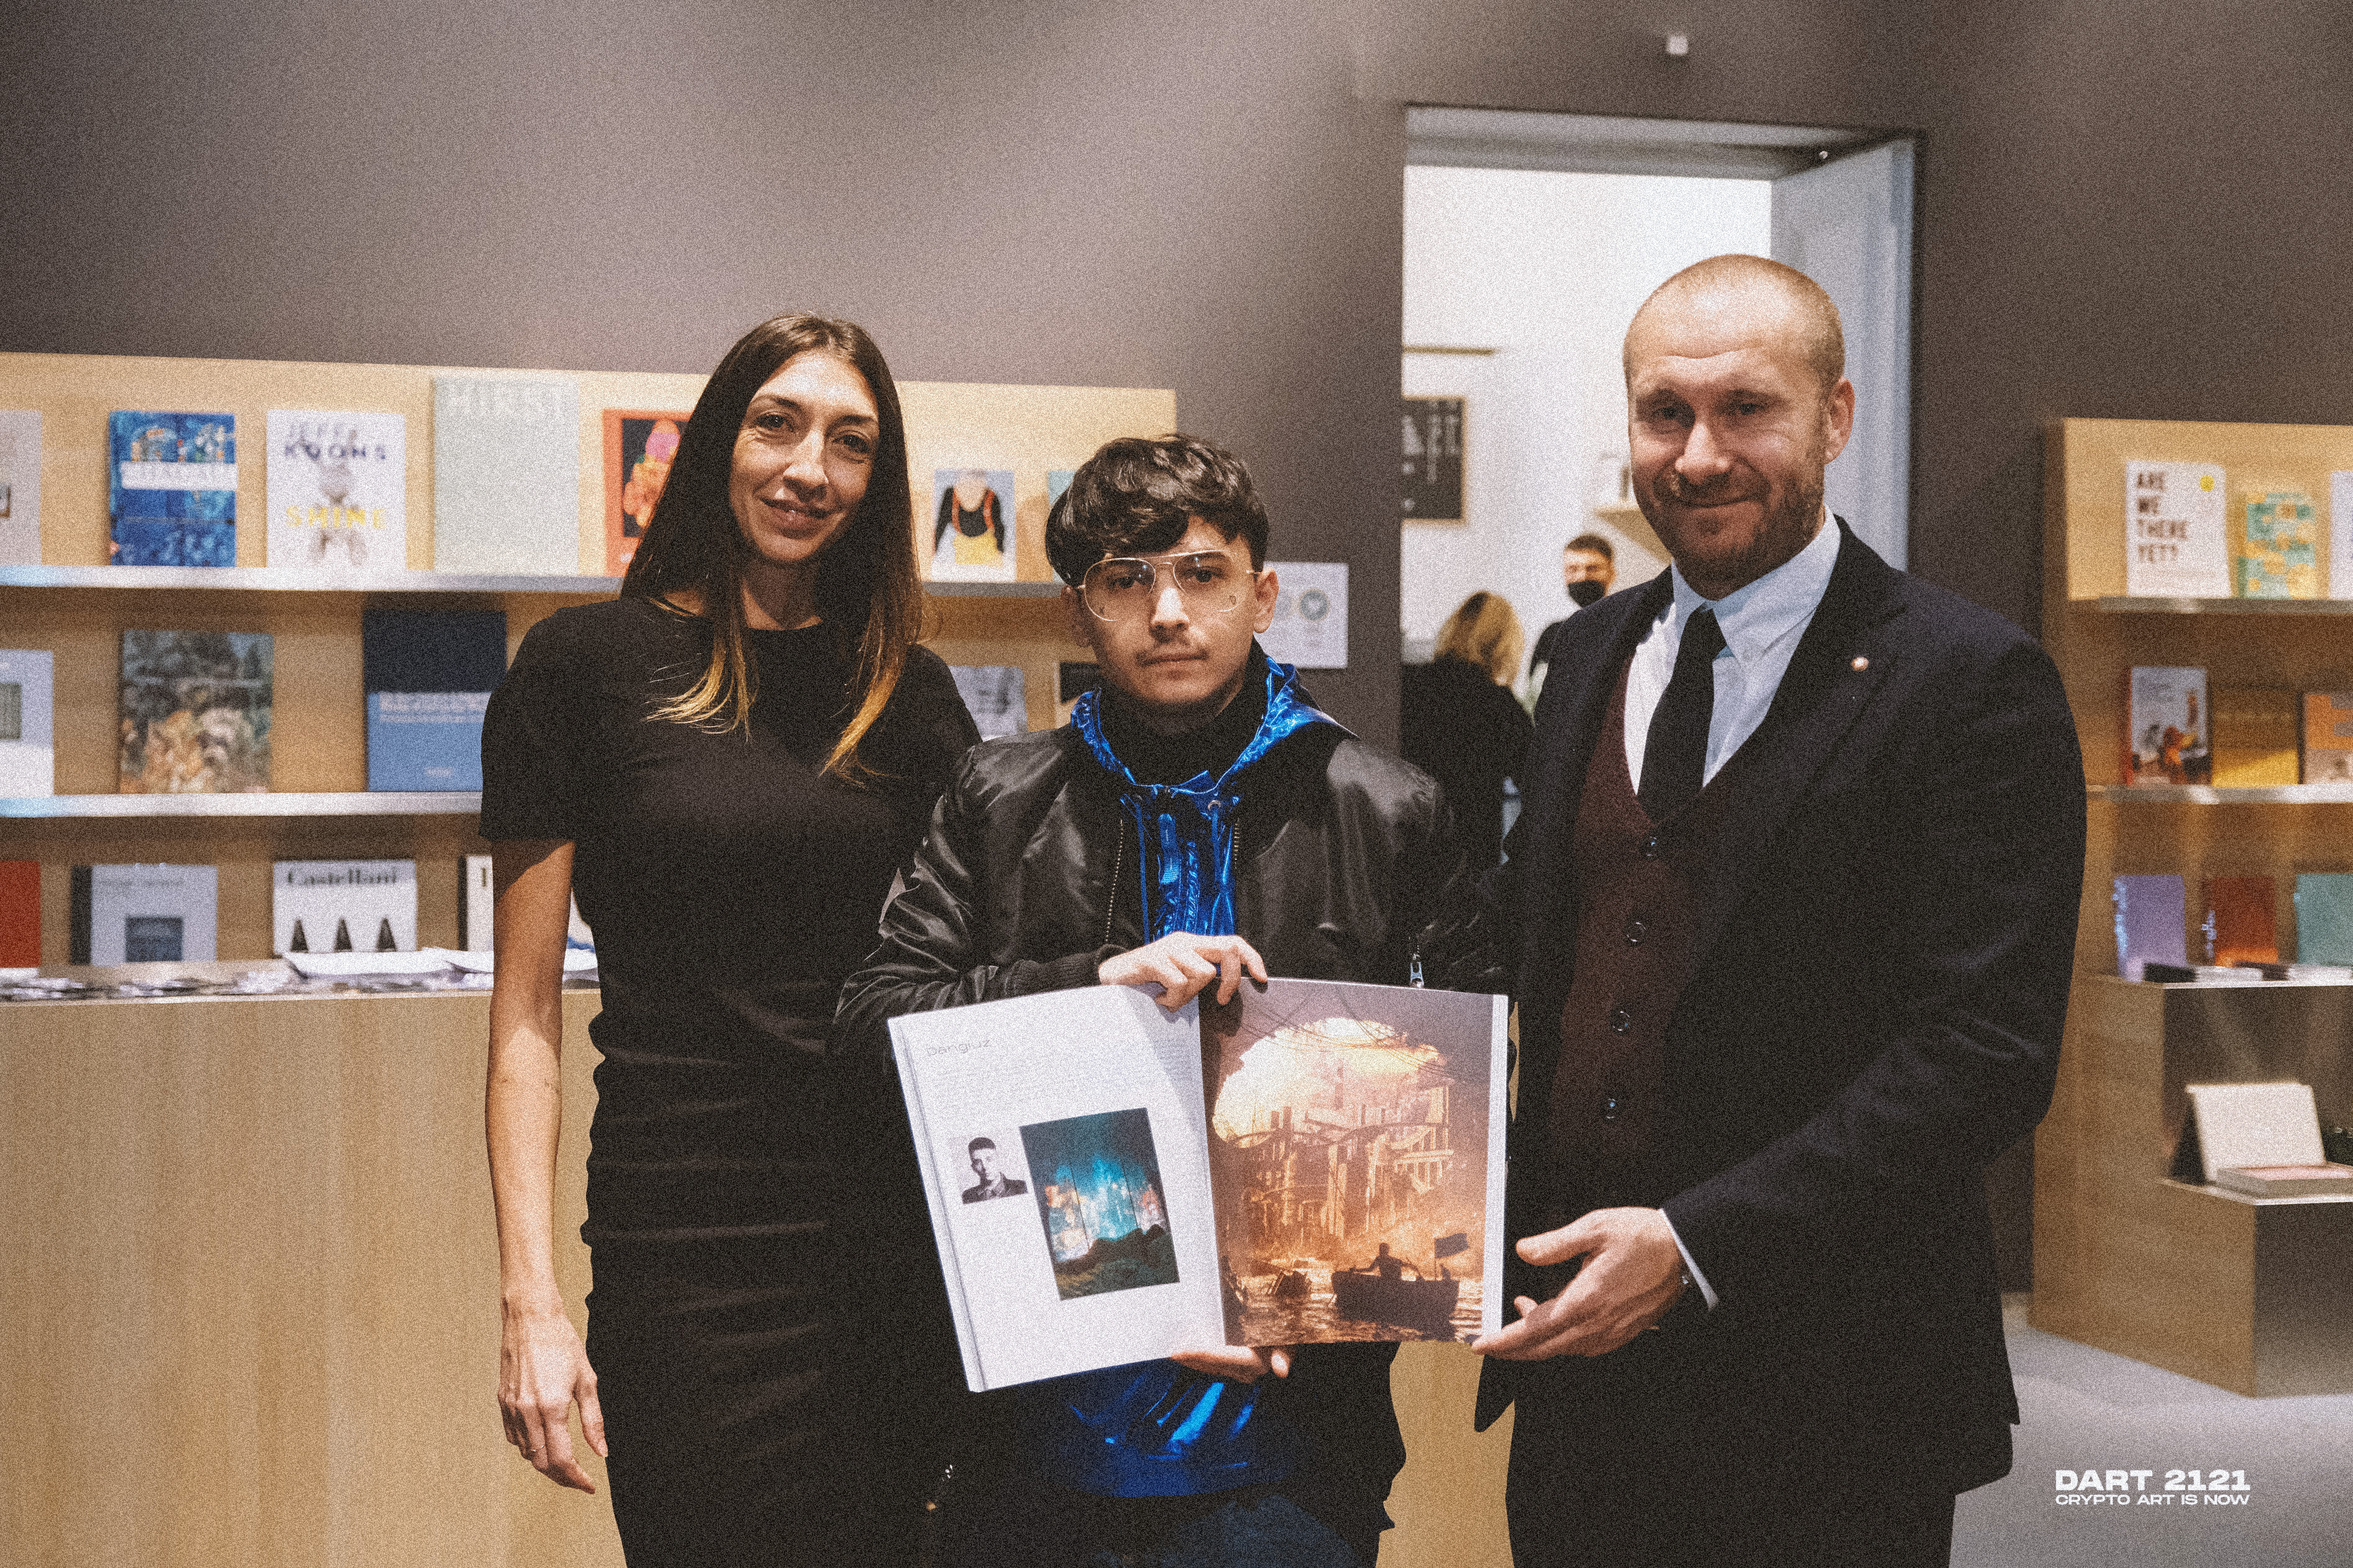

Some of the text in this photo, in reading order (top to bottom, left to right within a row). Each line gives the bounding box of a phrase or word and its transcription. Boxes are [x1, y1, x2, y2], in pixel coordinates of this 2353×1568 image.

[446, 383, 570, 422] HIRST
[2137, 472, 2167, 491] ARE
[285, 505, 386, 530] SHINE
[2137, 519, 2189, 540] THERE
[287, 867, 398, 886] Castellani
